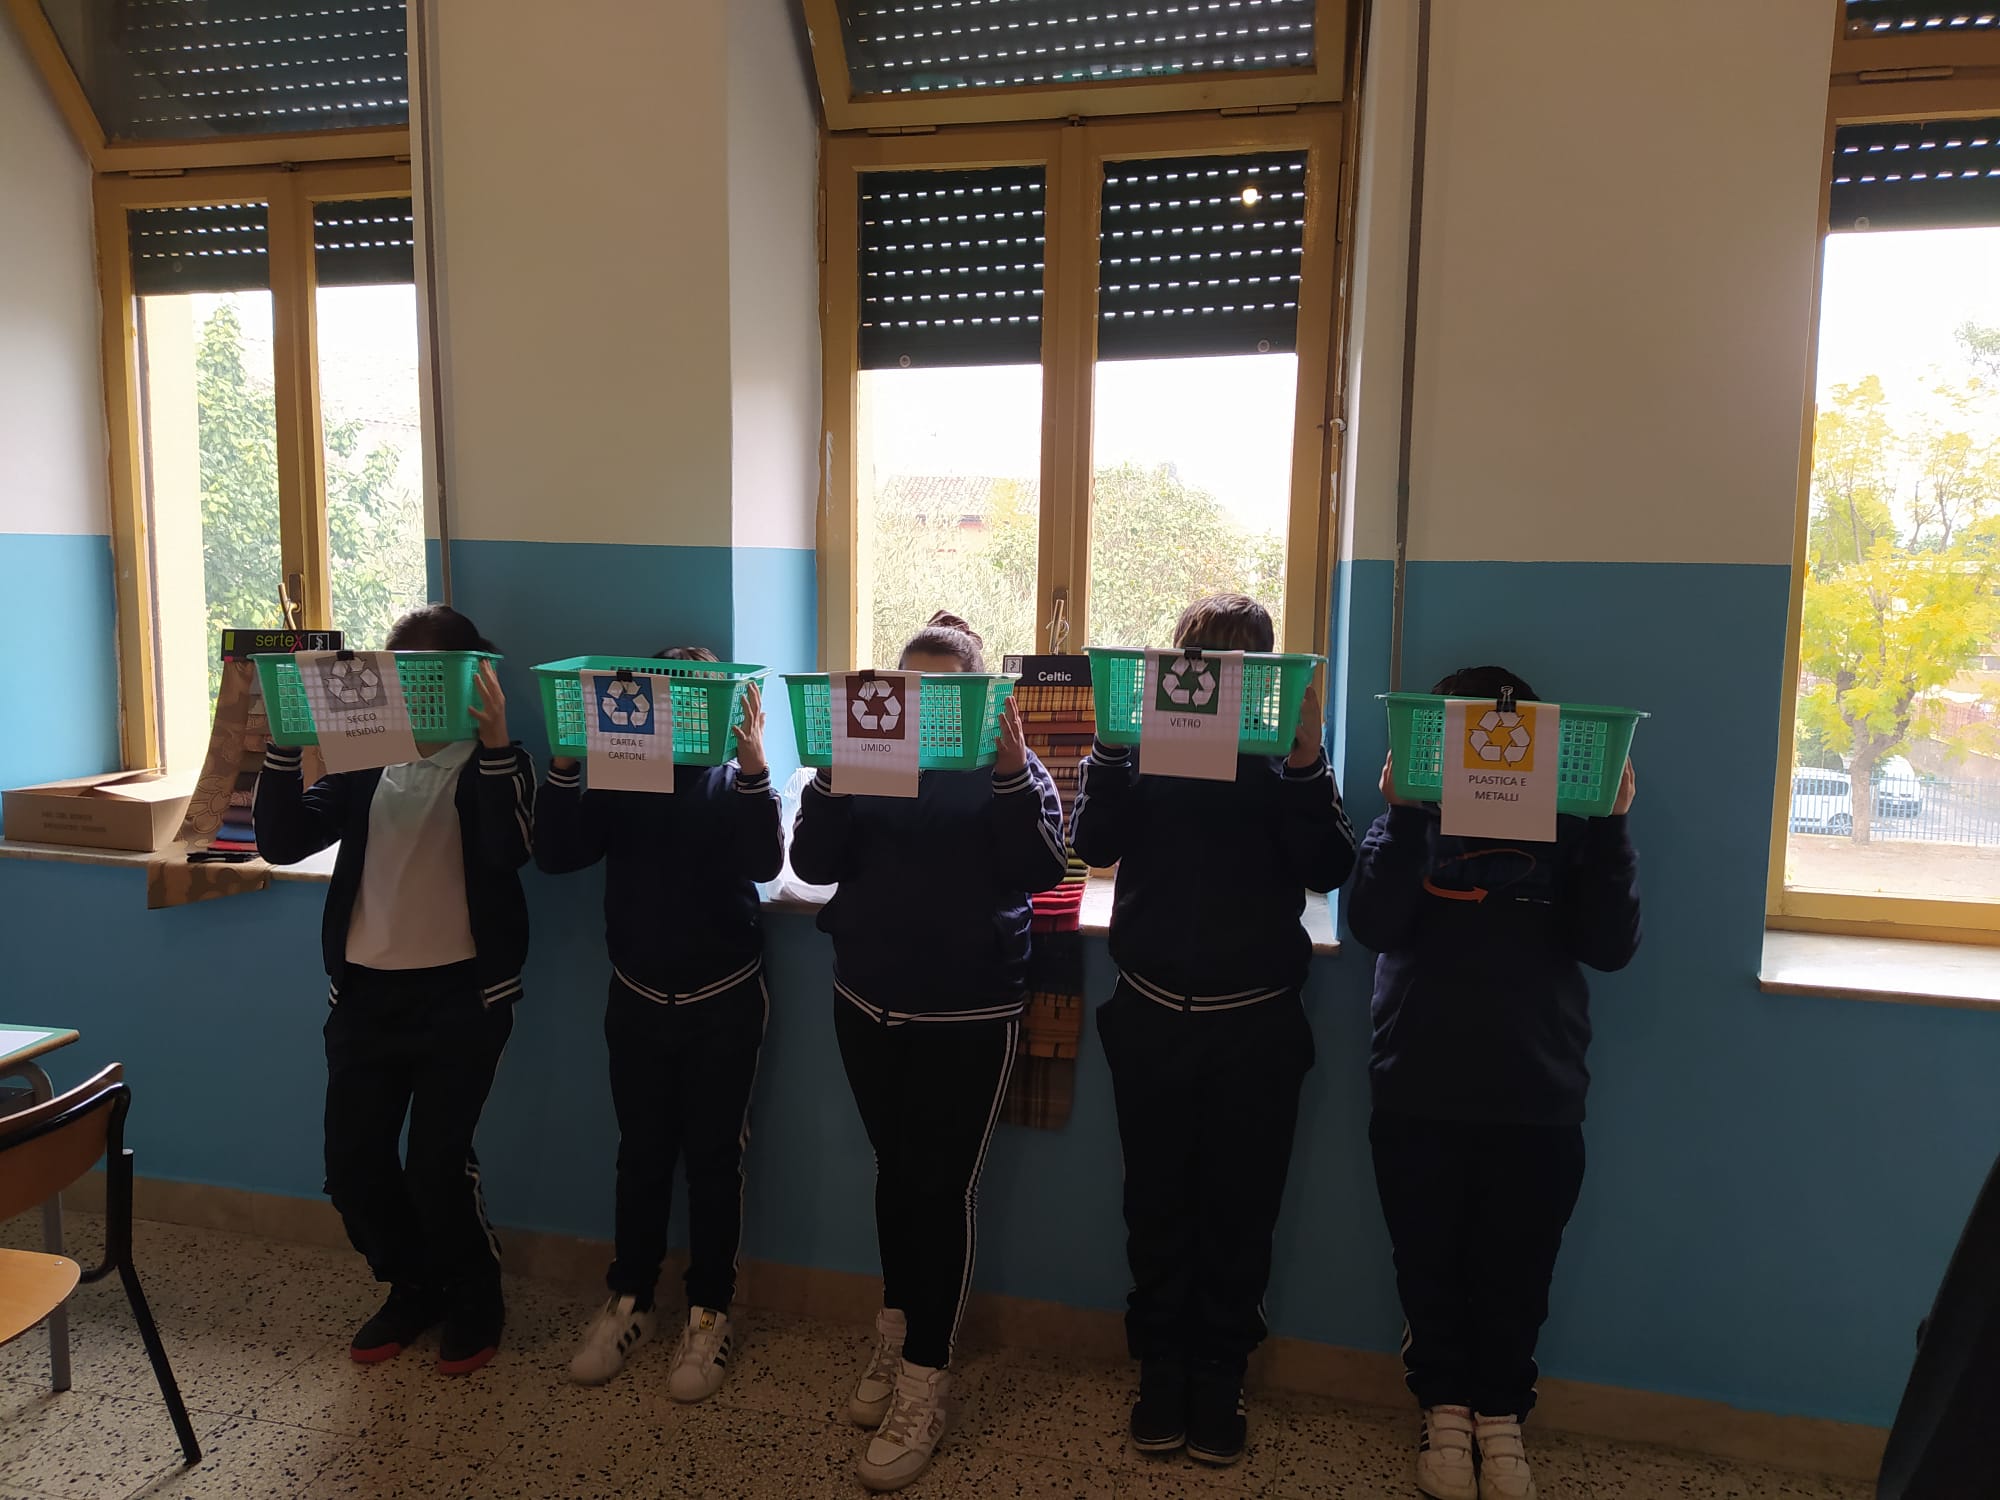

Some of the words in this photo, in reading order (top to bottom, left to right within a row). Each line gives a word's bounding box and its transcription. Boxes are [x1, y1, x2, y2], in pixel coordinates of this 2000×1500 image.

[1038, 671, 1072, 682] Celtic
[347, 712, 377, 724] SECCO
[1170, 717, 1201, 728] VETRO
[345, 725, 386, 738] RESIDUO
[610, 737, 637, 747] CARTA
[638, 739, 645, 747] E
[861, 743, 892, 753] UMIDO
[608, 751, 647, 761] CARTONE
[1468, 774, 1518, 786] PLASTICA
[1520, 777, 1528, 787] E
[1474, 790, 1520, 802] METALLI
